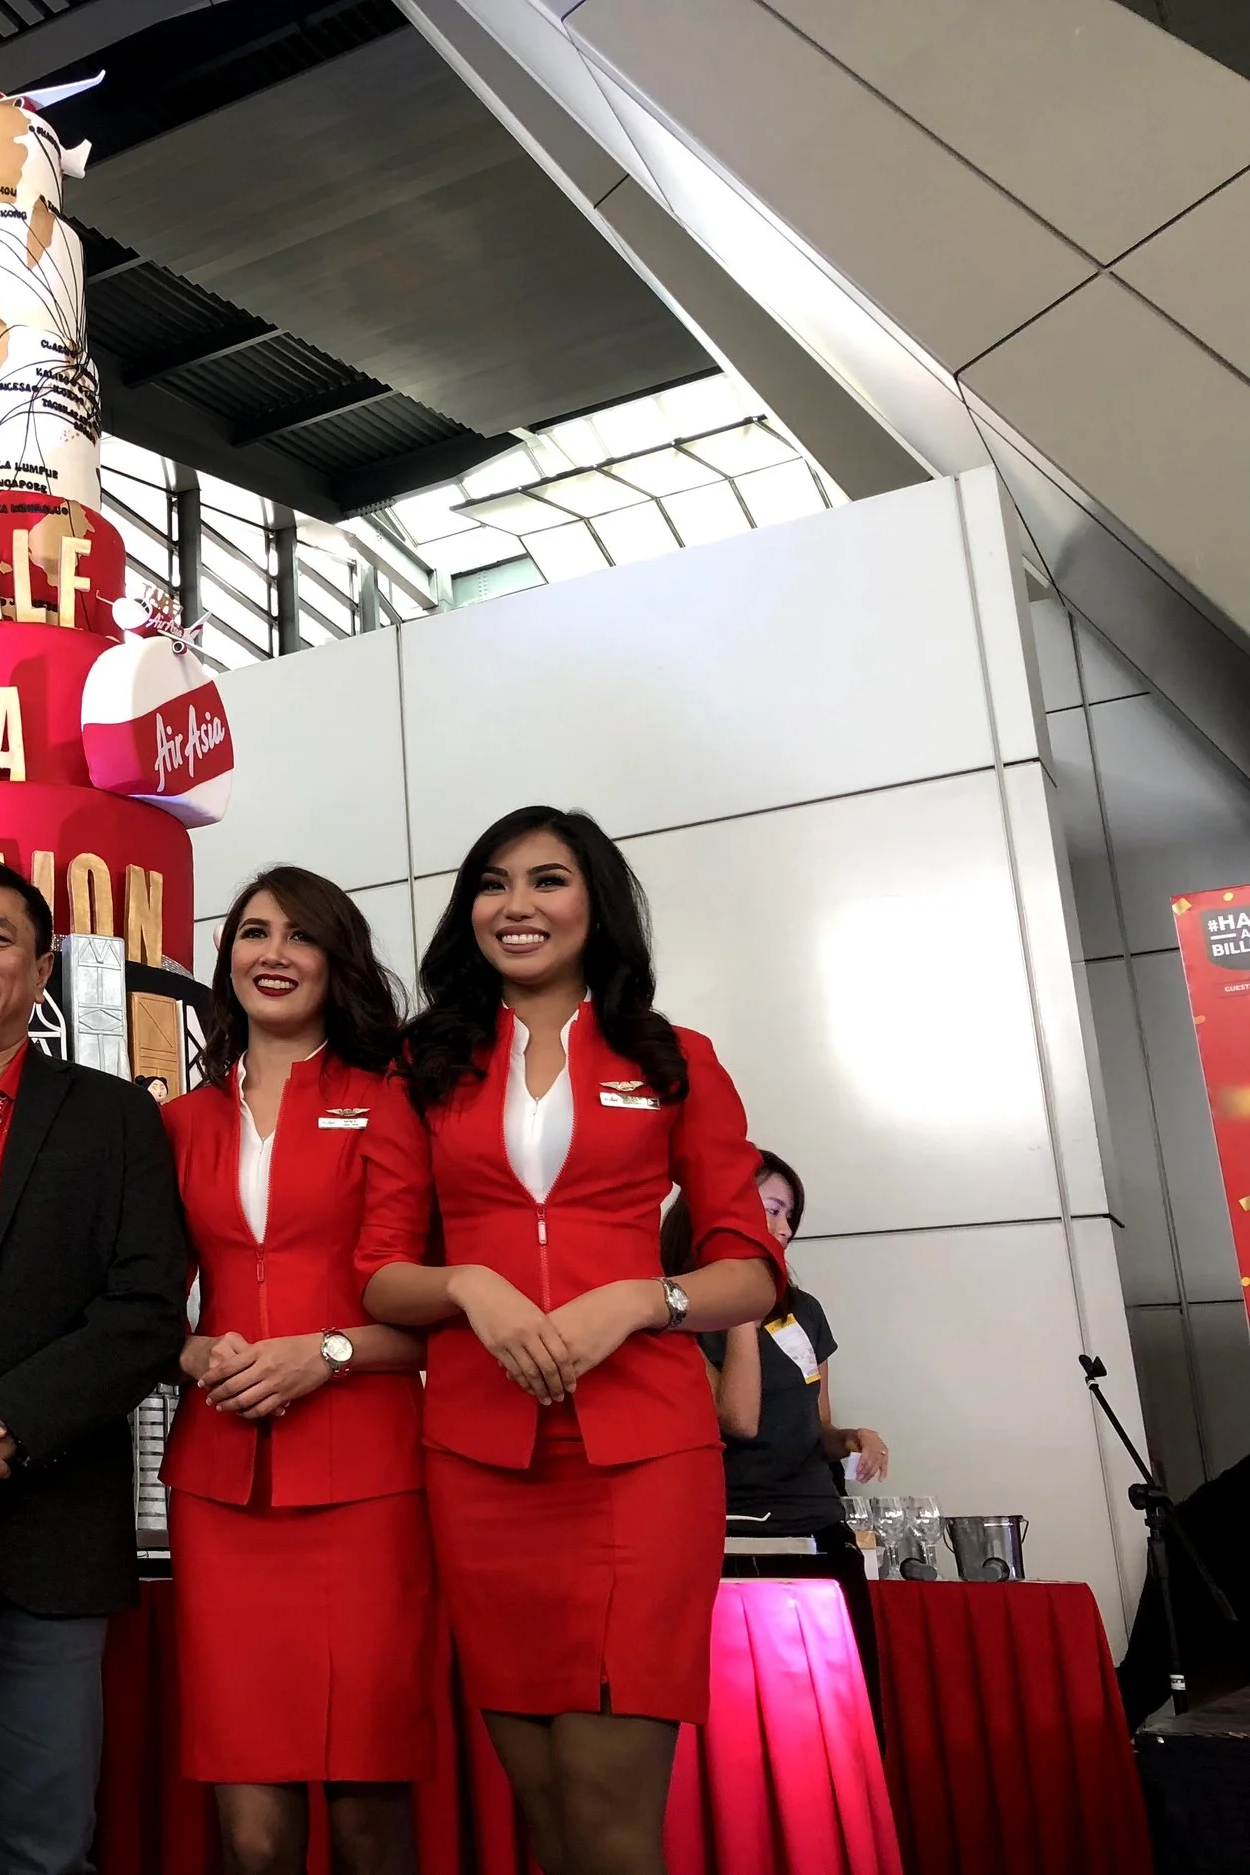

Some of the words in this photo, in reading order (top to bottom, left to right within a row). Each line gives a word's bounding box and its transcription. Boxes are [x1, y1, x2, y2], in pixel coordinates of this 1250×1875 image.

[15, 462, 59, 479] LUMPUR
[1207, 912, 1250, 932] #HA
[1211, 940, 1250, 957] BILL
[1224, 984, 1250, 992] GUEST
